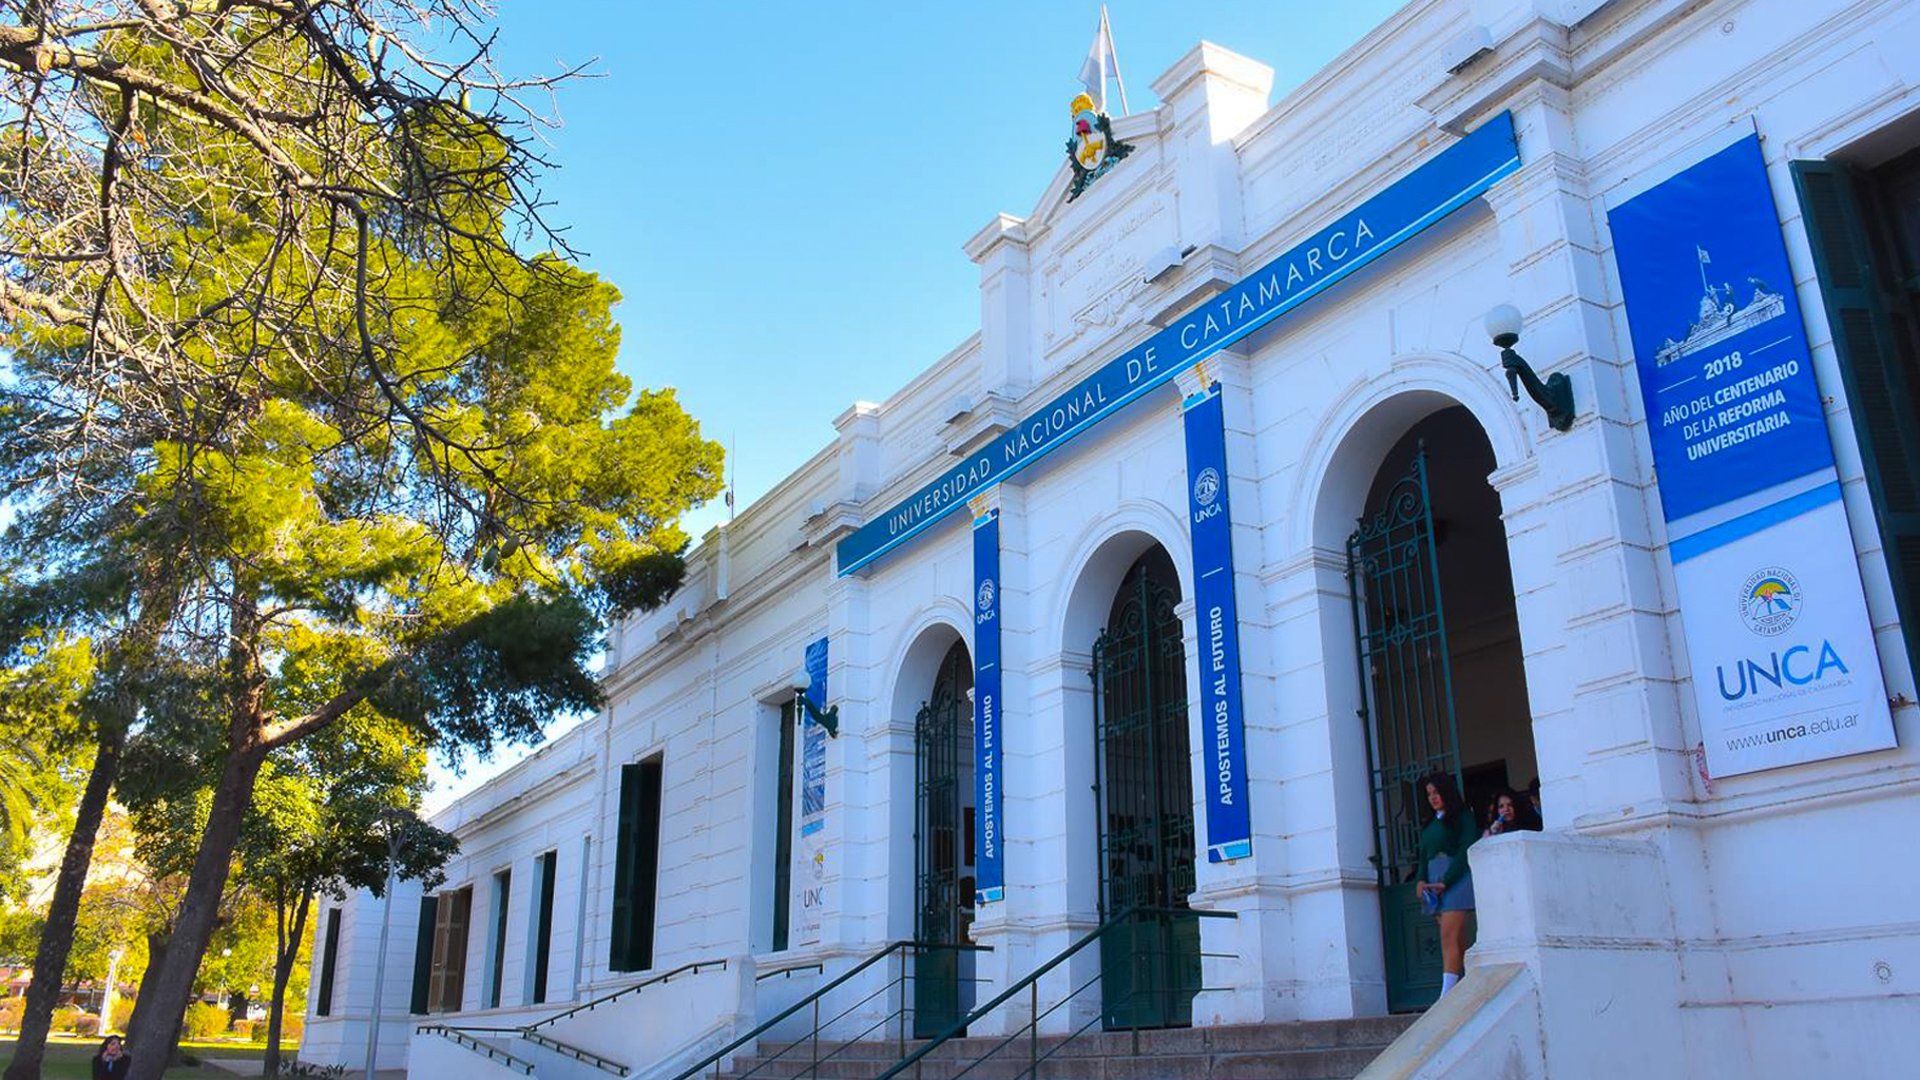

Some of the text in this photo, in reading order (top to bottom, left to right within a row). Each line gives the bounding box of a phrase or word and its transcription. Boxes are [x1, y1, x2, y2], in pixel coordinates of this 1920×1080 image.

[888, 457, 992, 536] UNIVERSIDAD
[1004, 383, 1107, 459] NACIONAL
[1126, 347, 1159, 384] DE
[1179, 217, 1375, 351] CATAMARCA
[1703, 351, 1743, 381] 2018
[1663, 360, 1800, 427] AÑO DEL CENTENARIO
[1684, 389, 1787, 441] DE LA REFORMA
[1687, 410, 1791, 462] UNIVERSITARIA
[1194, 502, 1223, 524] UNCA
[976, 610, 996, 625] UNCA
[1716, 638, 1850, 702] UNCA
[1210, 606, 1232, 806] APOSTEMOS AL FUTURO
[1726, 713, 1859, 752] www.unca.edu.ar
[983, 694, 994, 859] APOSTEMOS AL FUTURO
